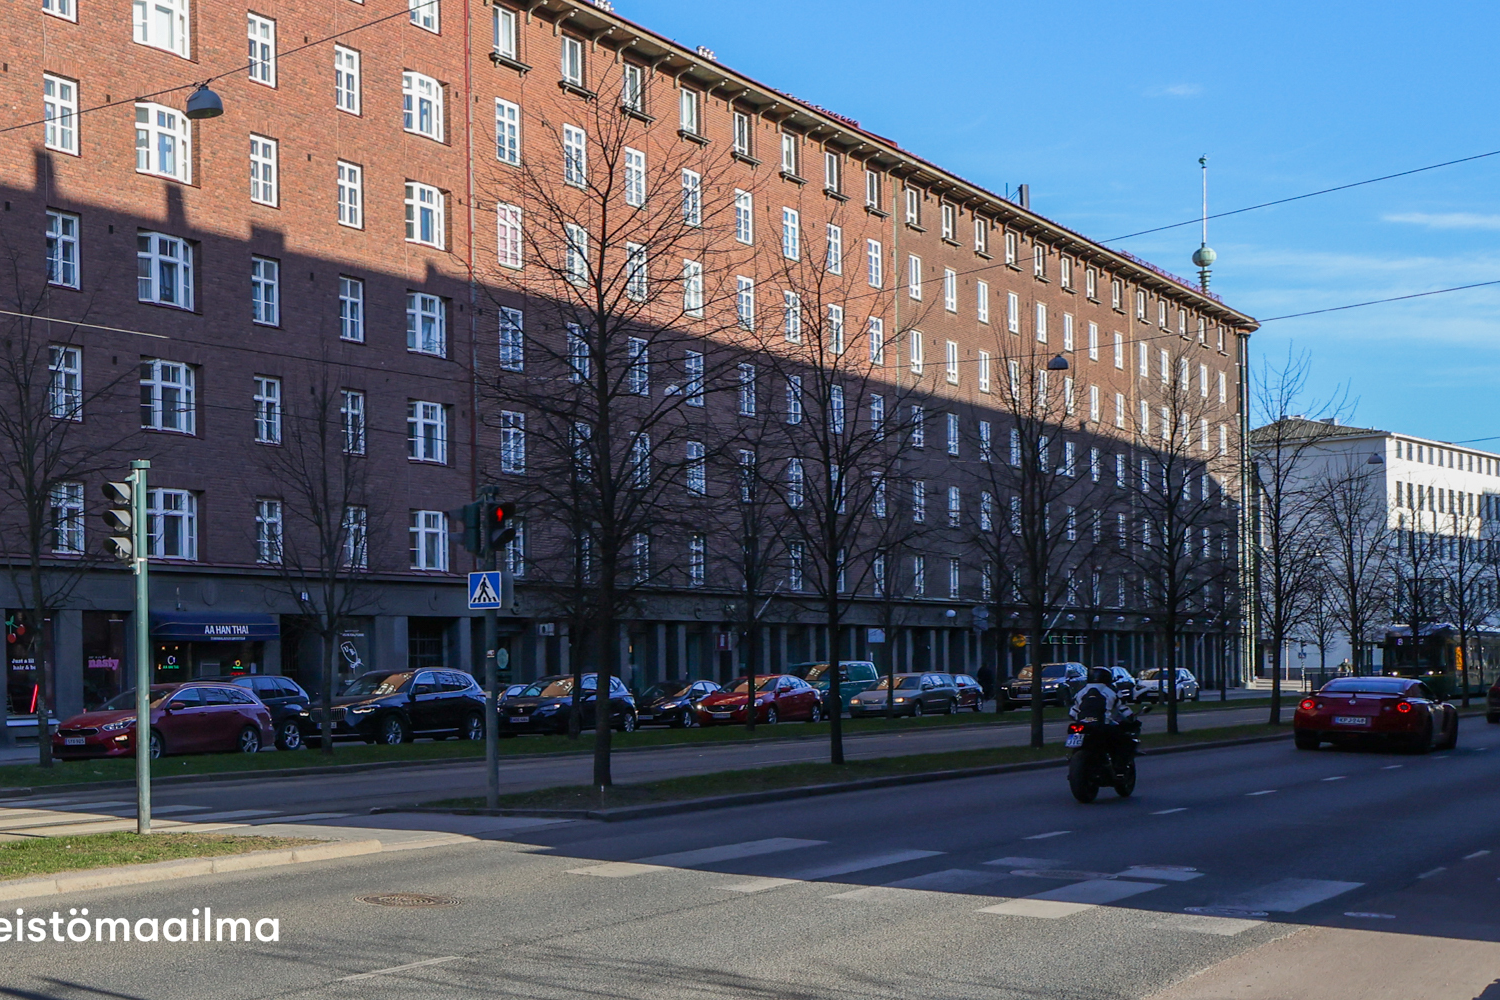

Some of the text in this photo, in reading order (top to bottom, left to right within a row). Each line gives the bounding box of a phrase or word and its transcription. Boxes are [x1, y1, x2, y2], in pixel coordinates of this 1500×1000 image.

[204, 625, 249, 635] AA HAN THAI
[88, 657, 119, 671] nasty
